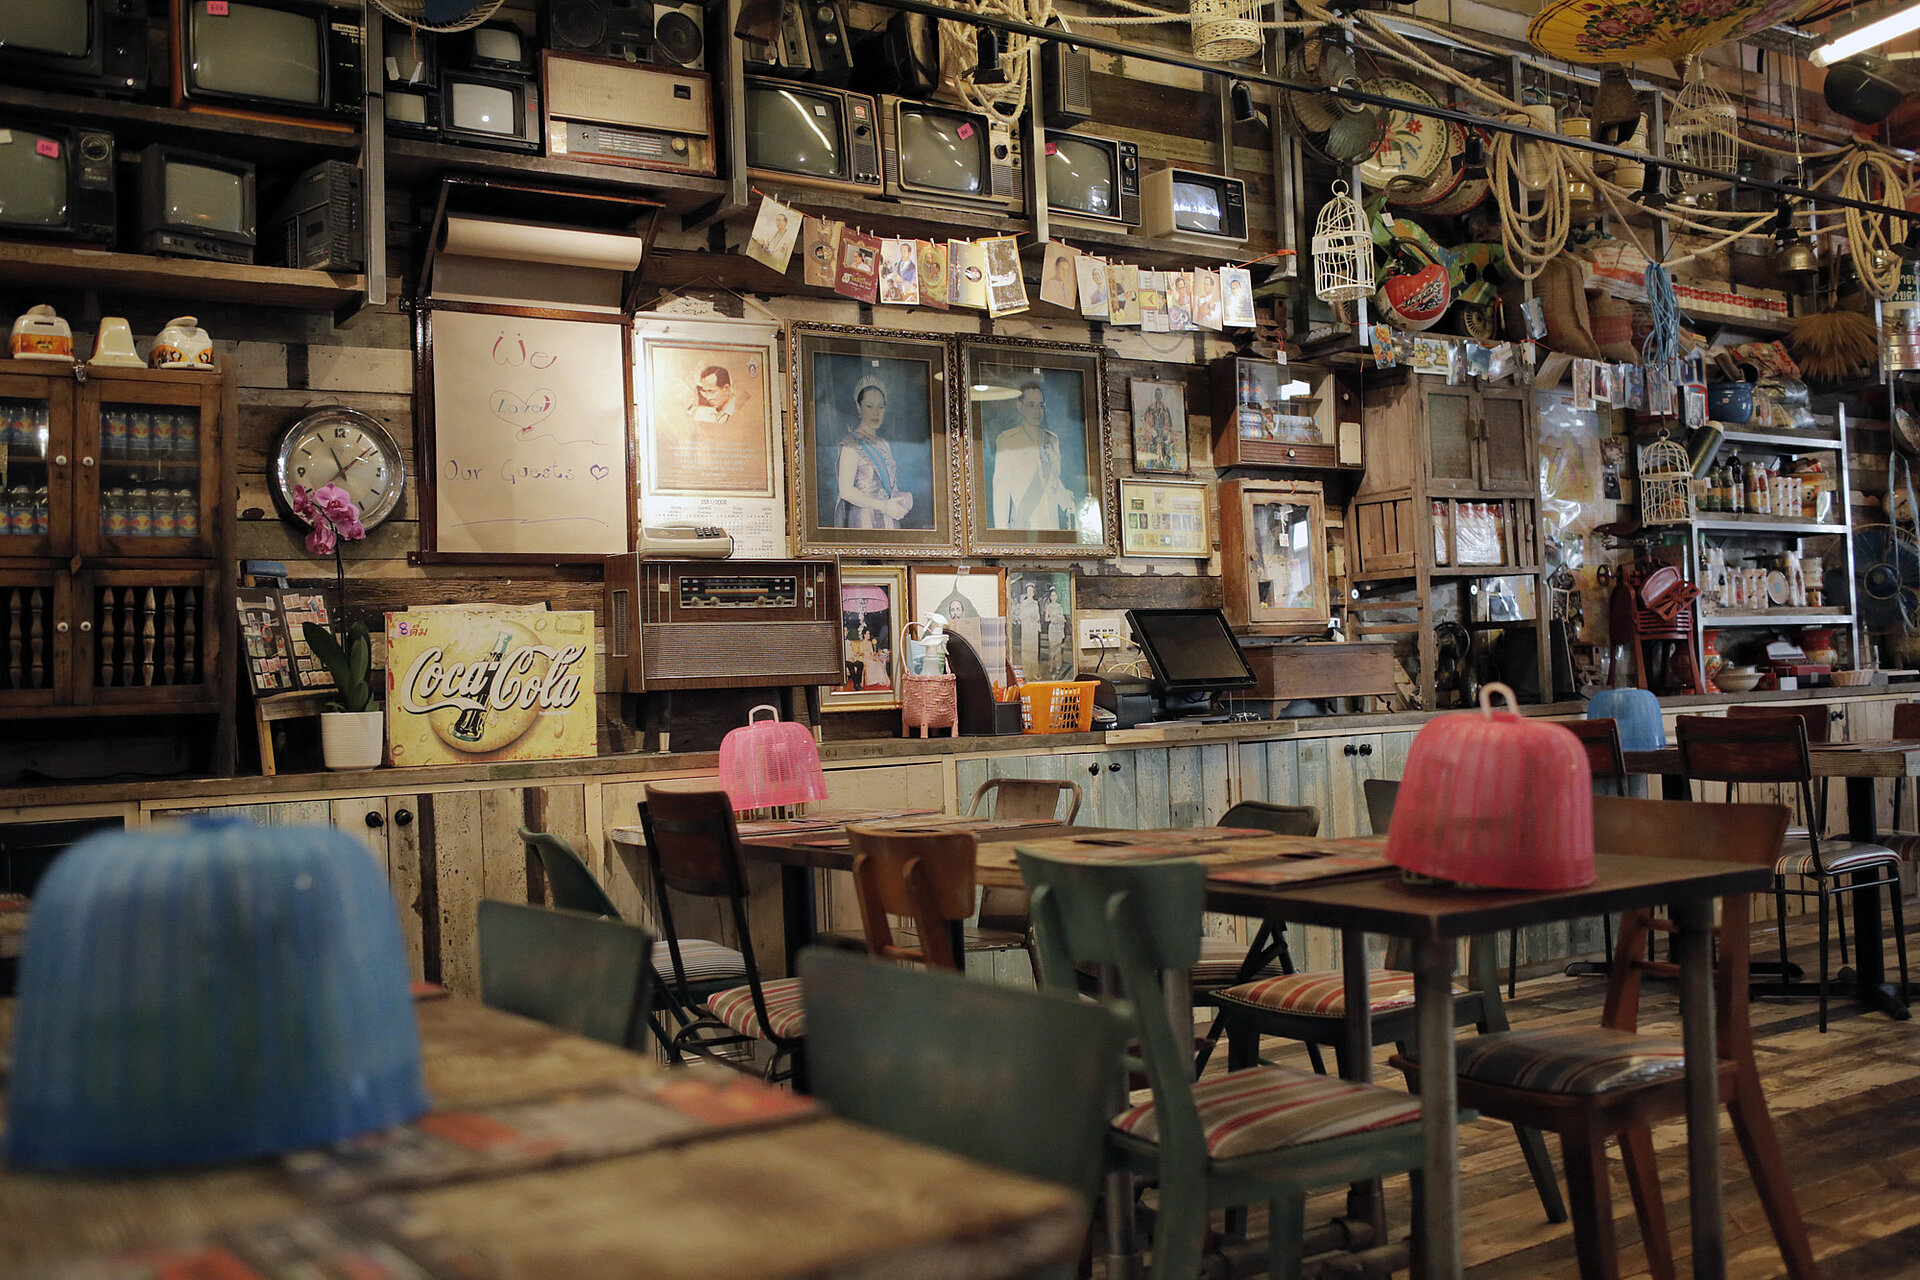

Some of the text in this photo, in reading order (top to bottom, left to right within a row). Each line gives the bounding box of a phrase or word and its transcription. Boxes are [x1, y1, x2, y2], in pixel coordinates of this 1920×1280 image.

[492, 331, 558, 370] We
[334, 427, 347, 439] 12
[297, 466, 306, 478] 9
[443, 458, 576, 485] Our Guests
[401, 644, 587, 715] Coca-Cola
